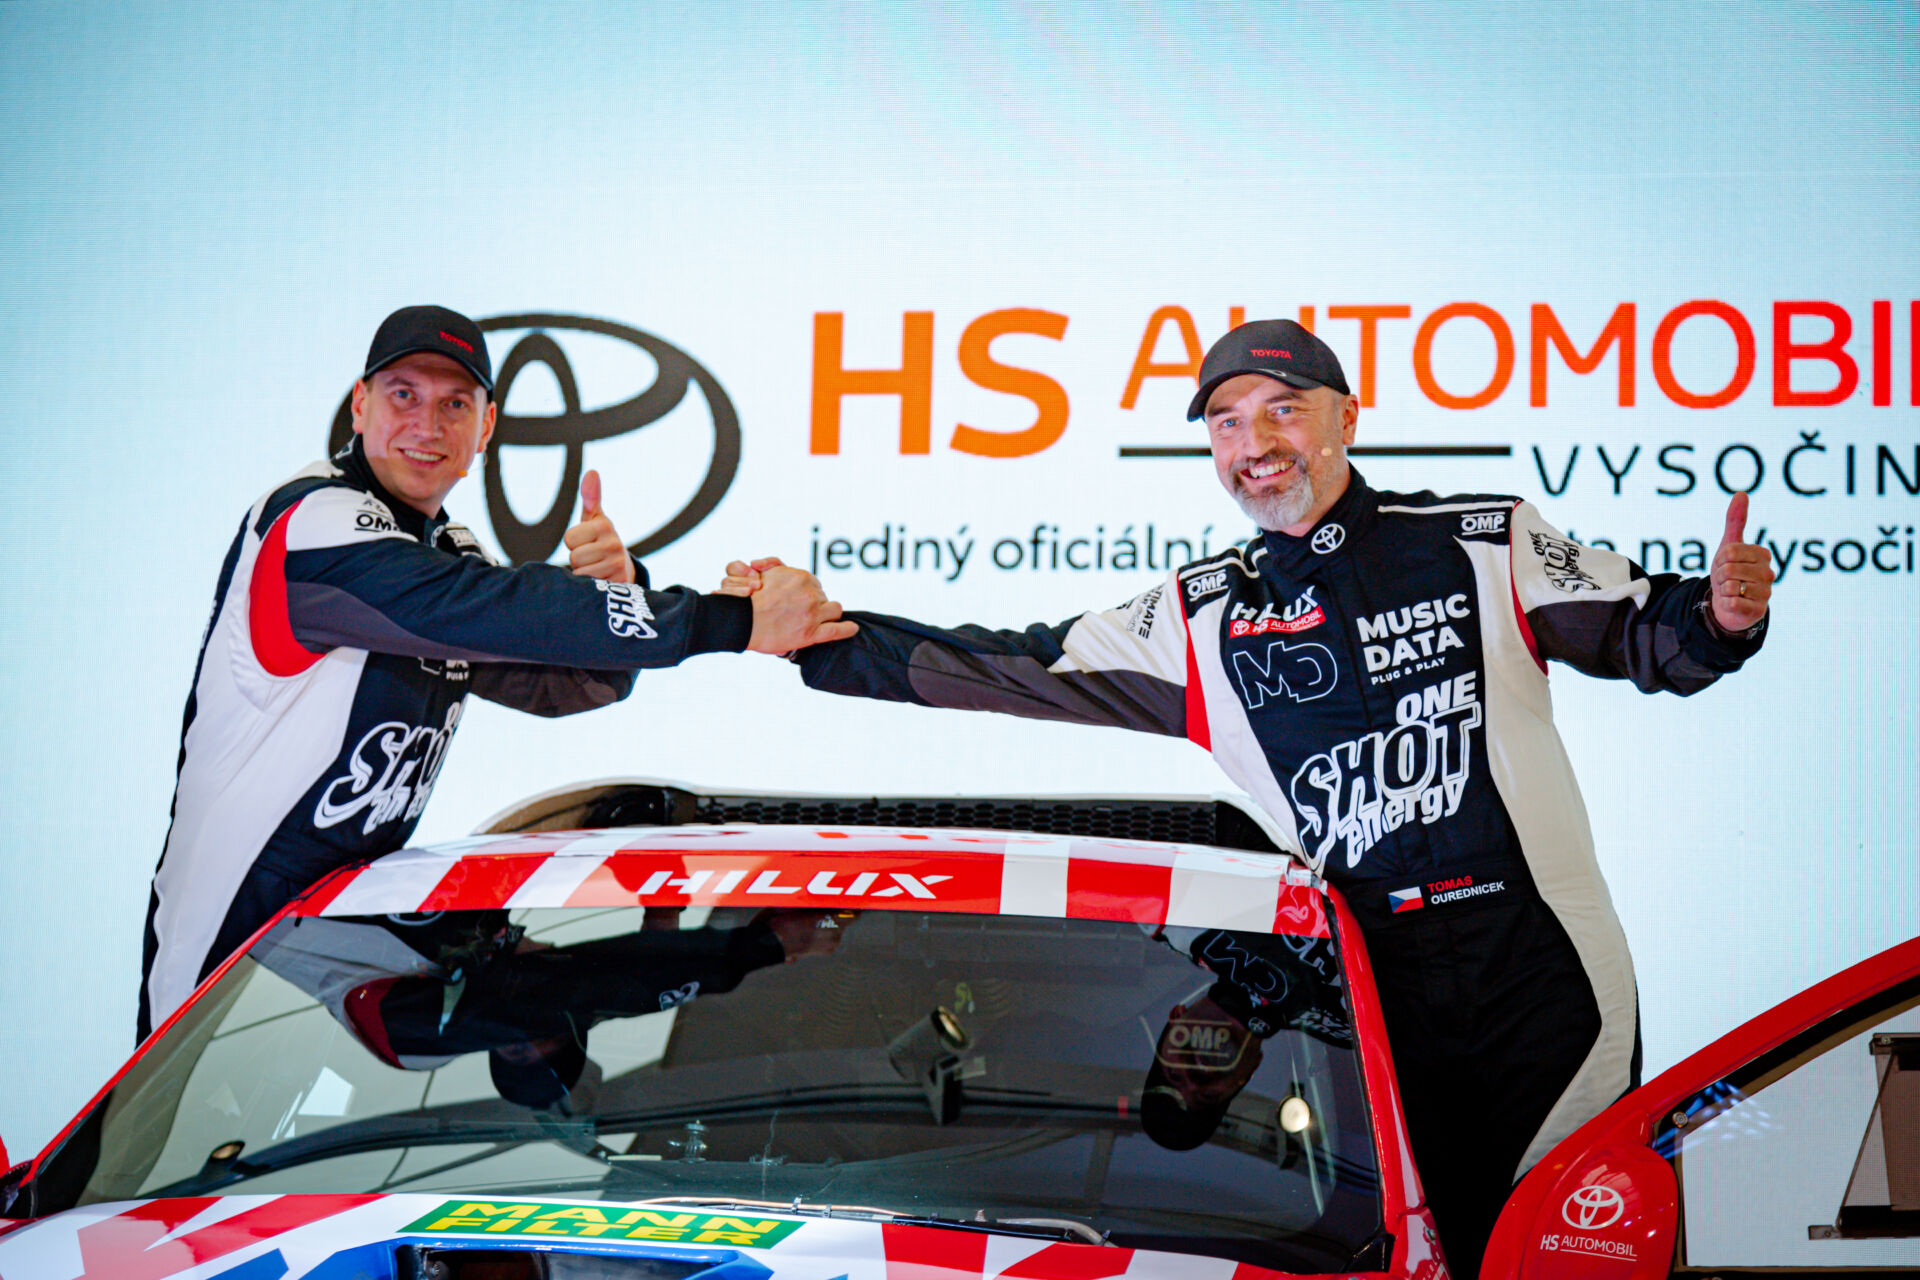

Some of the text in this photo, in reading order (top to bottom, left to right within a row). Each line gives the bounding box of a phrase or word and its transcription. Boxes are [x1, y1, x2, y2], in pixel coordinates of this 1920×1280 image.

[439, 331, 474, 354] TOYOTA
[1250, 348, 1292, 360] TOYOTA
[809, 299, 1920, 459] HS ATOMOBI
[356, 513, 399, 532] OM
[1461, 514, 1505, 532] OMP
[811, 523, 975, 581] jediný
[991, 523, 1214, 571] oficiální
[1641, 539, 1708, 572] na
[1186, 572, 1227, 598] OMP
[607, 582, 658, 639] SHO
[1270, 610, 1322, 629] AUTOMOBIL
[1356, 593, 1471, 642] MUSIC
[1363, 626, 1465, 673] DATA
[1371, 657, 1446, 685] PLUG & PLAY
[1395, 670, 1477, 726] ONE
[313, 721, 454, 829] SHO
[1291, 701, 1482, 874] SHOT
[1346, 778, 1468, 869] energy
[637, 870, 954, 899] HILUX
[1426, 875, 1474, 893] TOMAS
[1431, 881, 1505, 904] OUREDNICEK
[1168, 1025, 1231, 1049] OMP
[425, 1217, 762, 1246] FILTER
[449, 1202, 780, 1234] MANN
[1540, 1234, 1638, 1257] HS AUTOMOBIL
